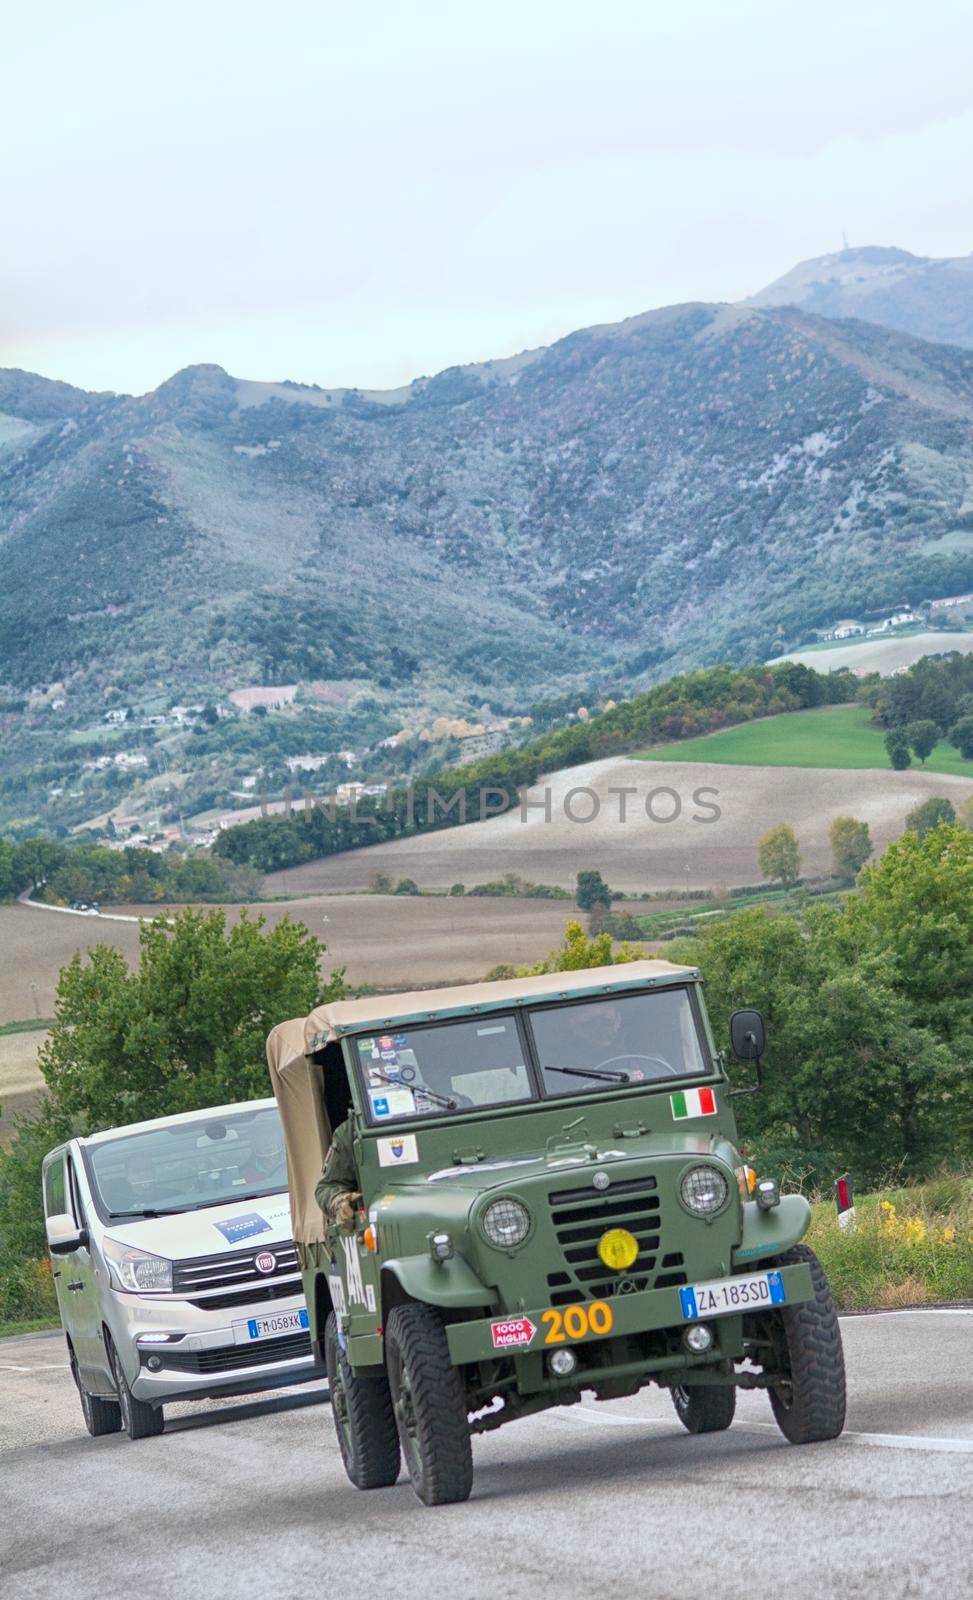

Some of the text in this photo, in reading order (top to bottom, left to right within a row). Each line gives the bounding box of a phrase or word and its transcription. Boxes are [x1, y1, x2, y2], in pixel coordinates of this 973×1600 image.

[496, 1322, 524, 1334] 1000
[541, 1301, 613, 1344] 200
[496, 1331, 528, 1344] MIGLIA
